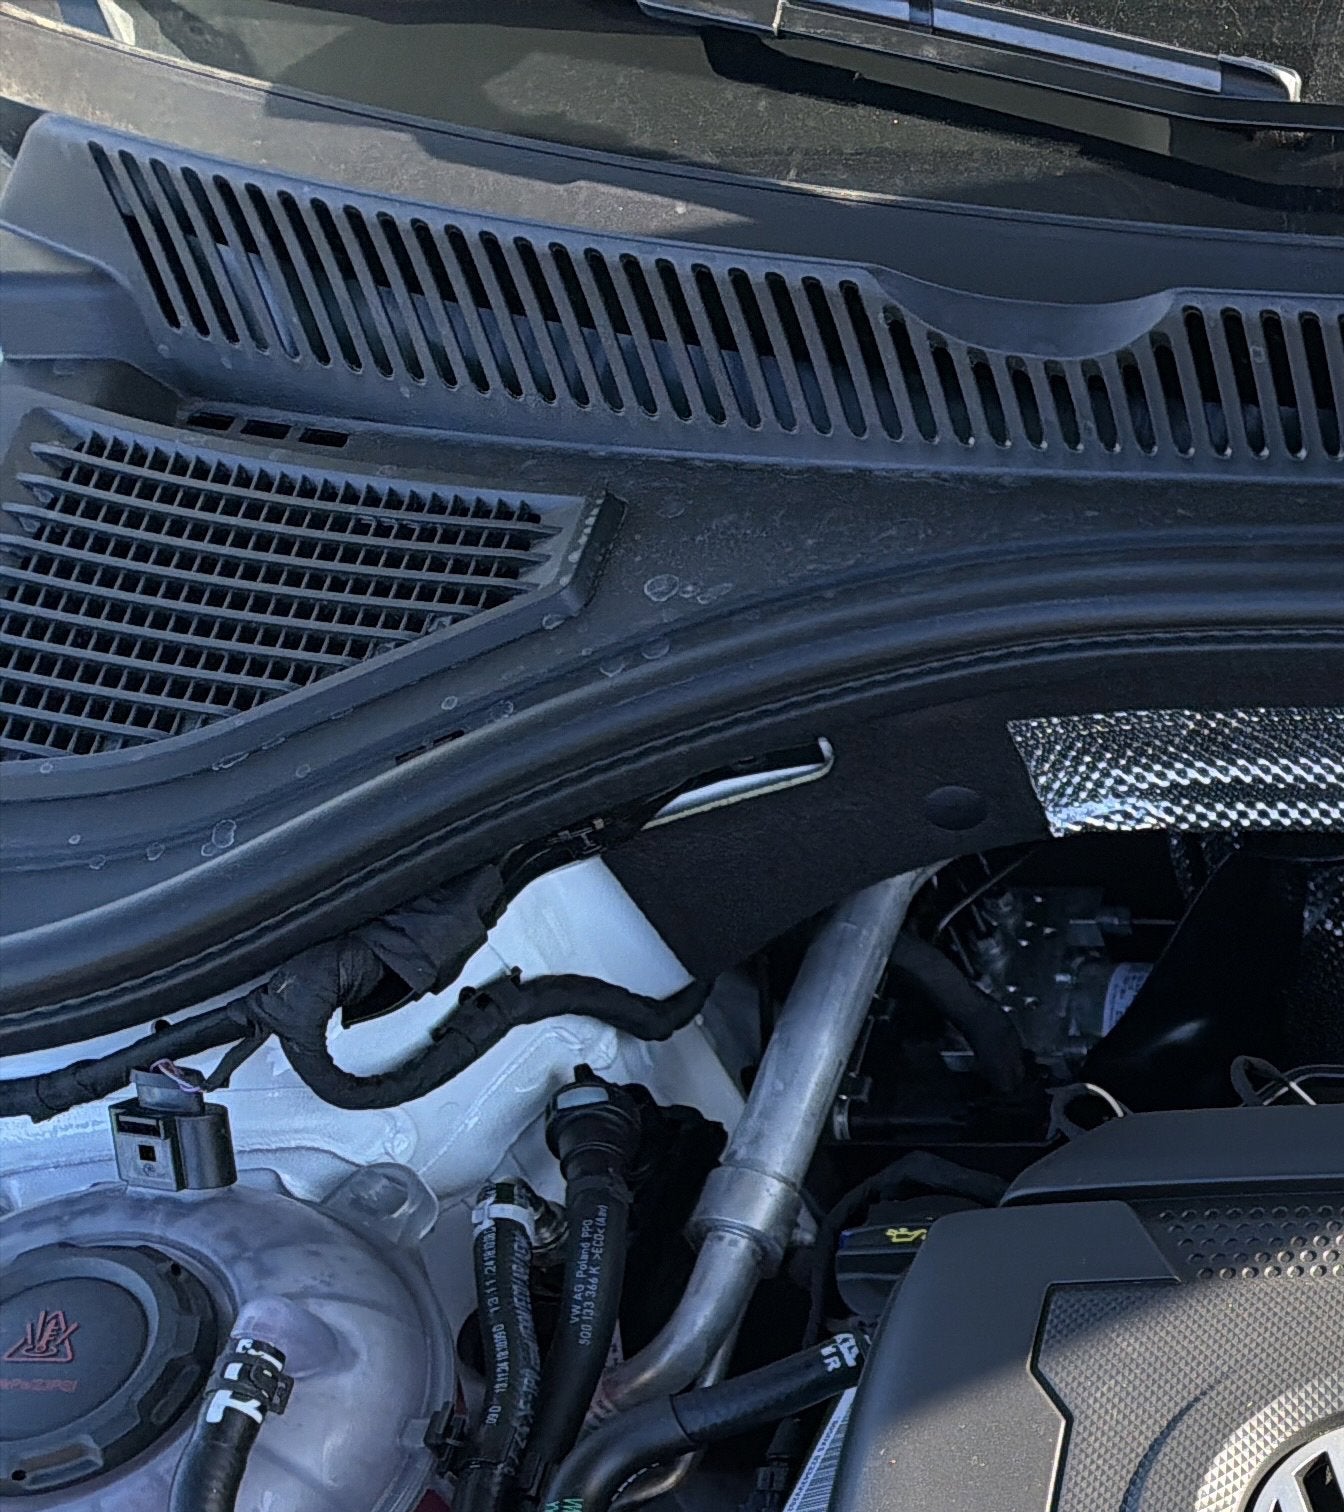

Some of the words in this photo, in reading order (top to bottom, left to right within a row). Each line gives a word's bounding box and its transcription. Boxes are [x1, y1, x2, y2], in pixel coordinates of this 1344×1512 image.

[576, 1242, 590, 1278] Poland
[589, 1266, 600, 1276] K
[573, 1284, 584, 1300] AG
[588, 1278, 598, 1300] 366
[570, 1299, 581, 1324] VW
[585, 1303, 595, 1322] 133
